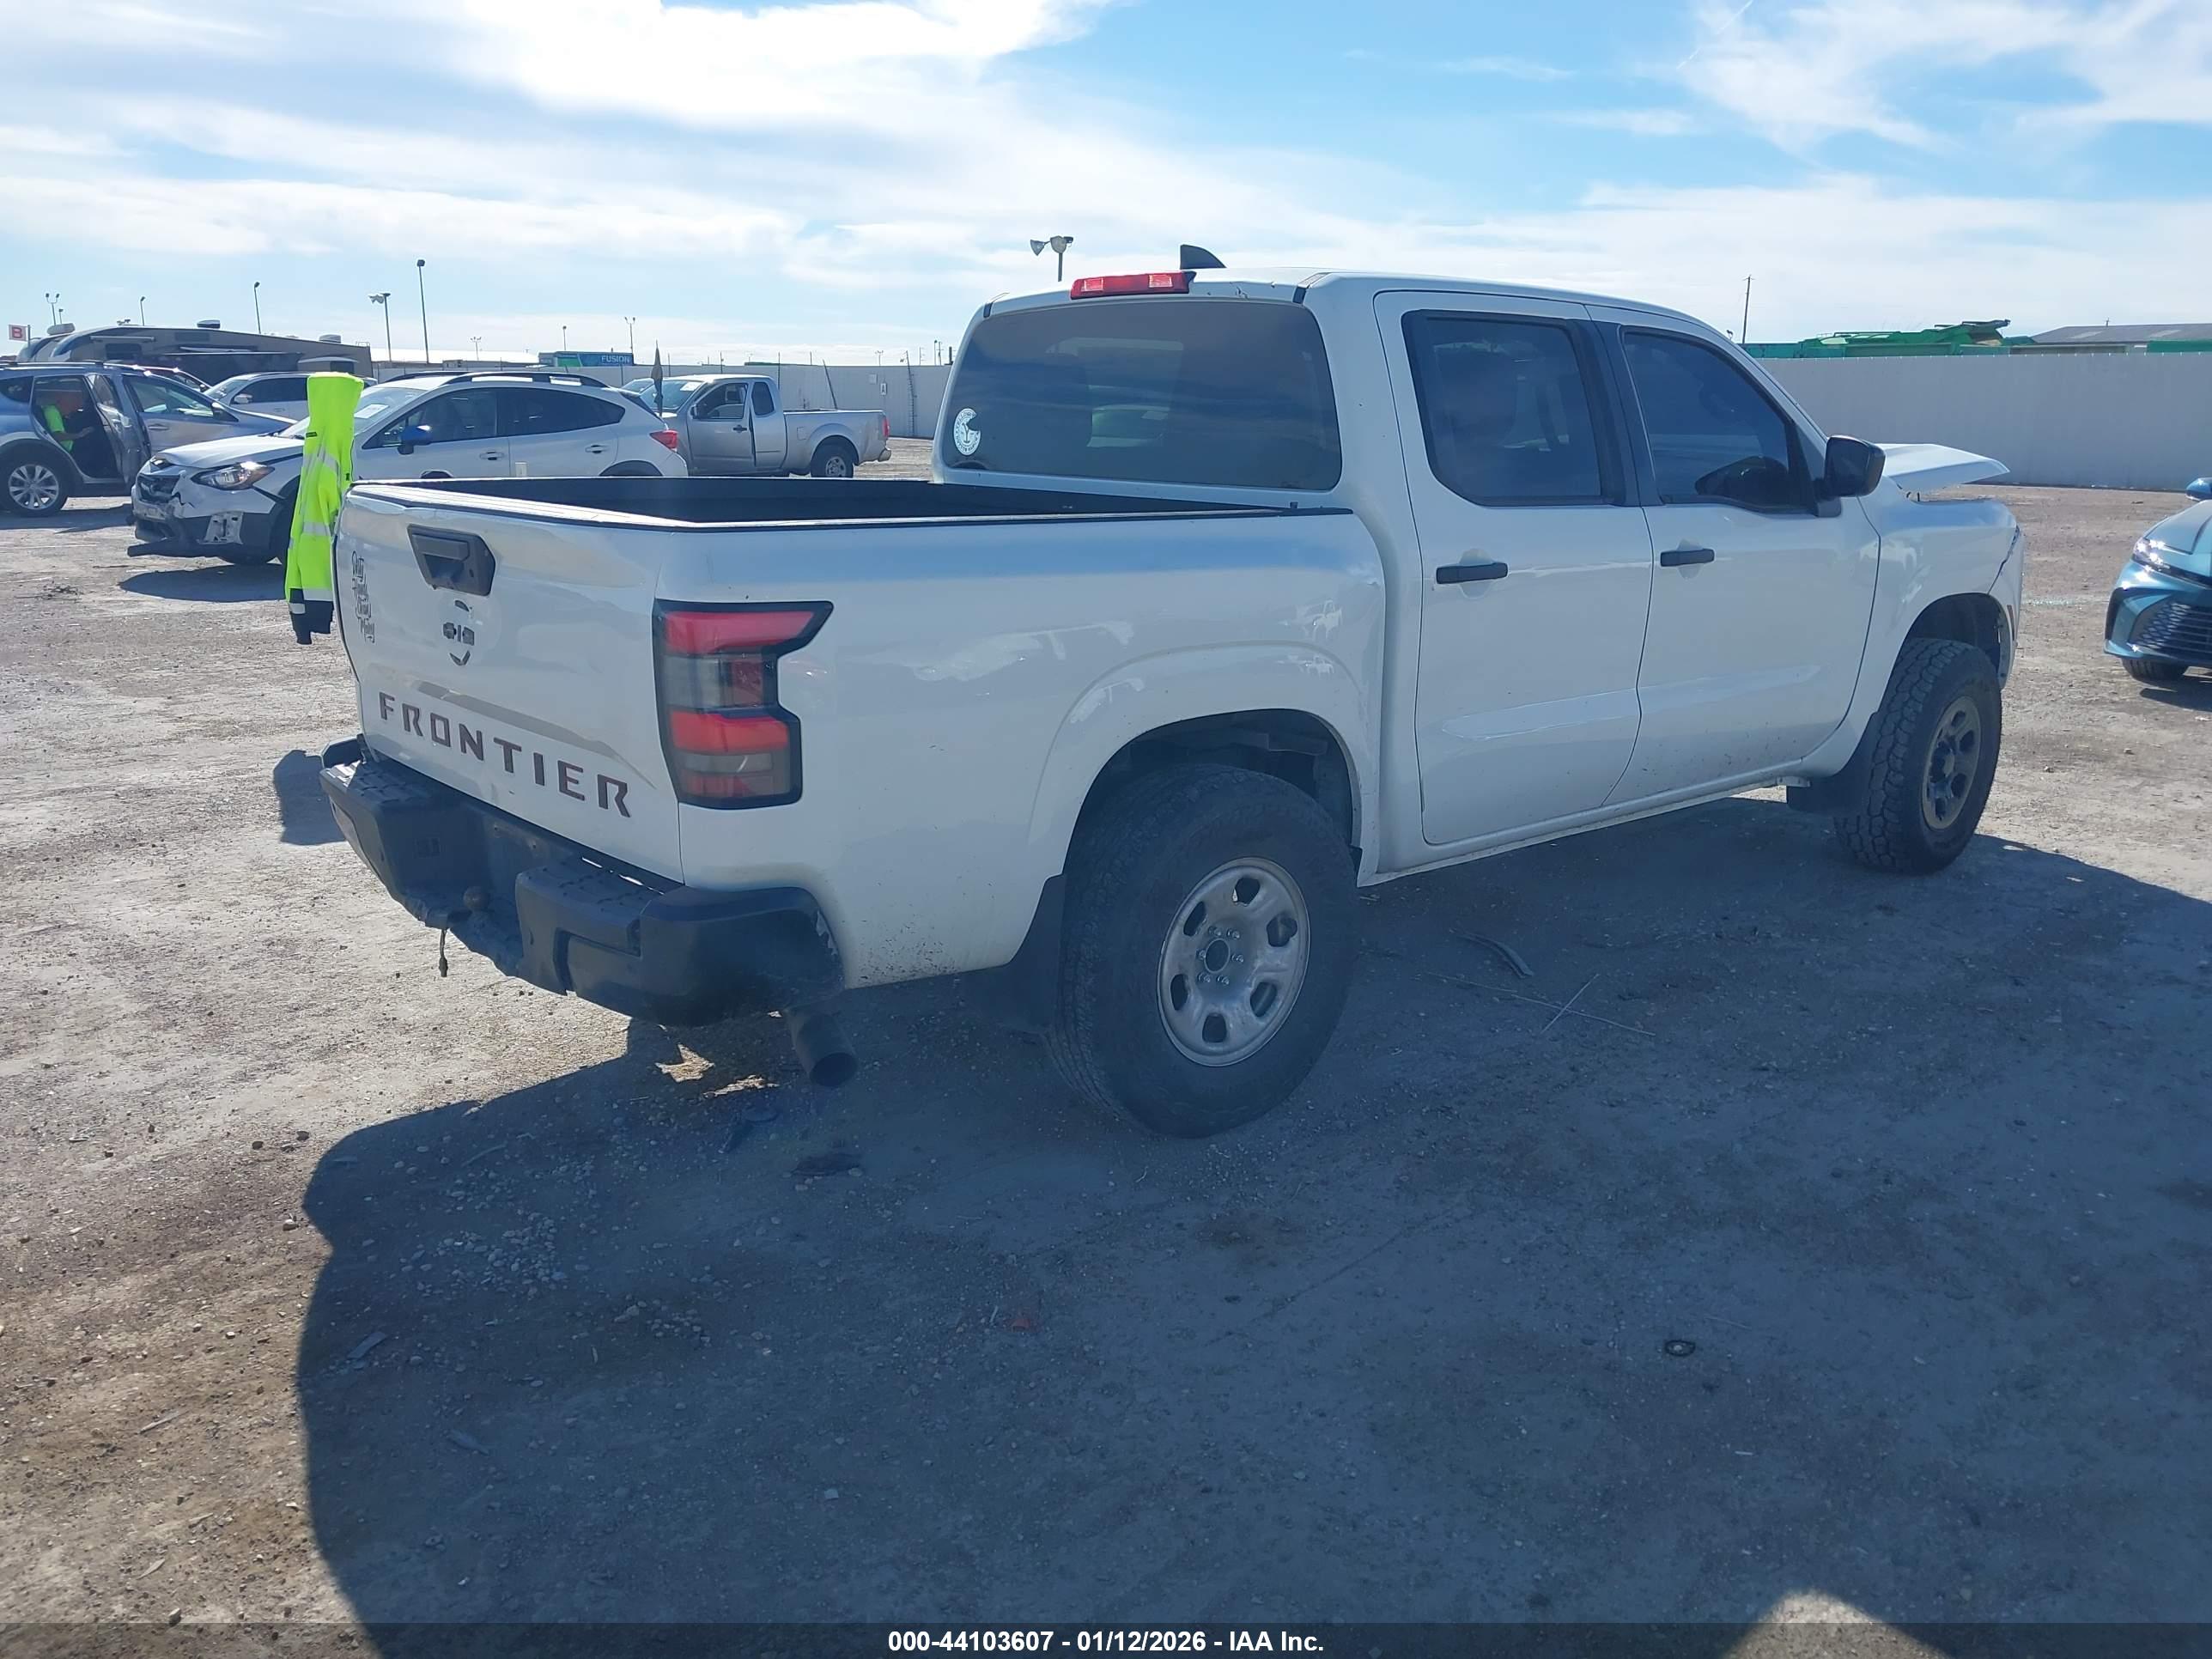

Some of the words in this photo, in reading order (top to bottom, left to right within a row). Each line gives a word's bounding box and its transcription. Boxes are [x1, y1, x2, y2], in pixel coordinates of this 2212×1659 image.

[11, 326, 23, 339] B
[601, 355, 629, 363] FUSION
[379, 691, 631, 818] FRONTIER
